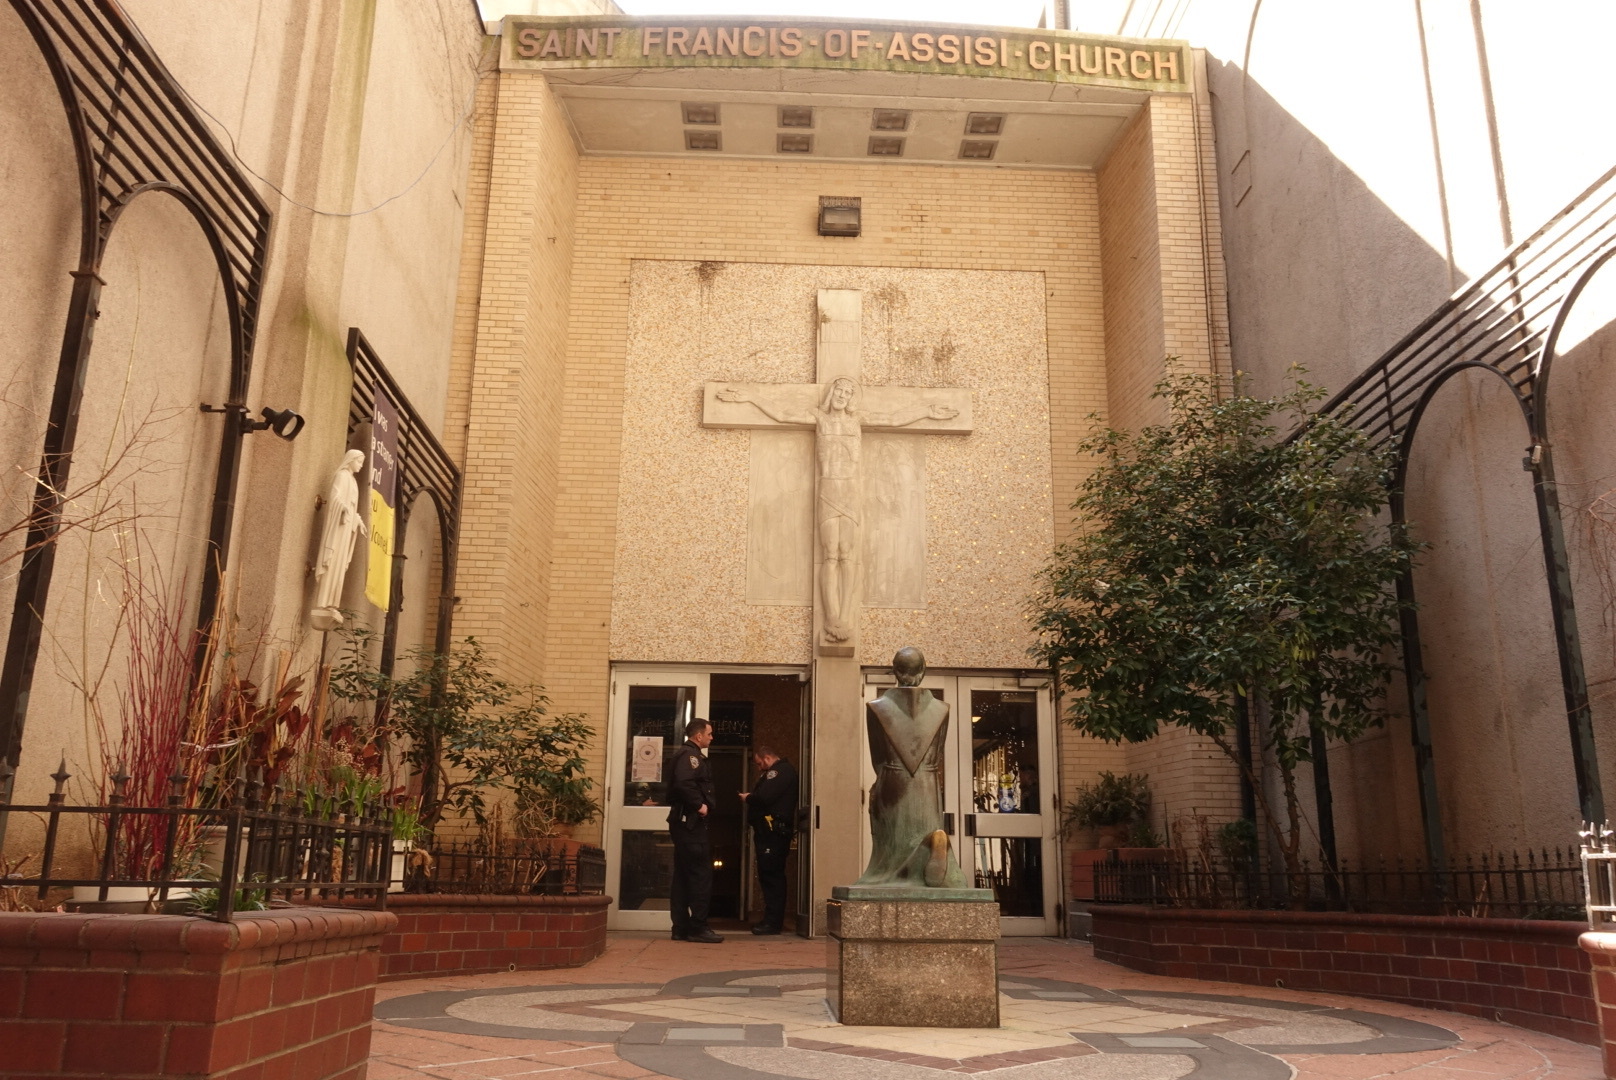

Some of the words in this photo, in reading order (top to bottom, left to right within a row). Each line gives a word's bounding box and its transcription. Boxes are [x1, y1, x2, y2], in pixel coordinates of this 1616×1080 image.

[516, 27, 621, 58] SAINT
[642, 25, 803, 59] FRANCIS
[824, 28, 871, 59] OF
[886, 31, 1009, 68] ASSISI
[1028, 40, 1179, 81] CHURCH
